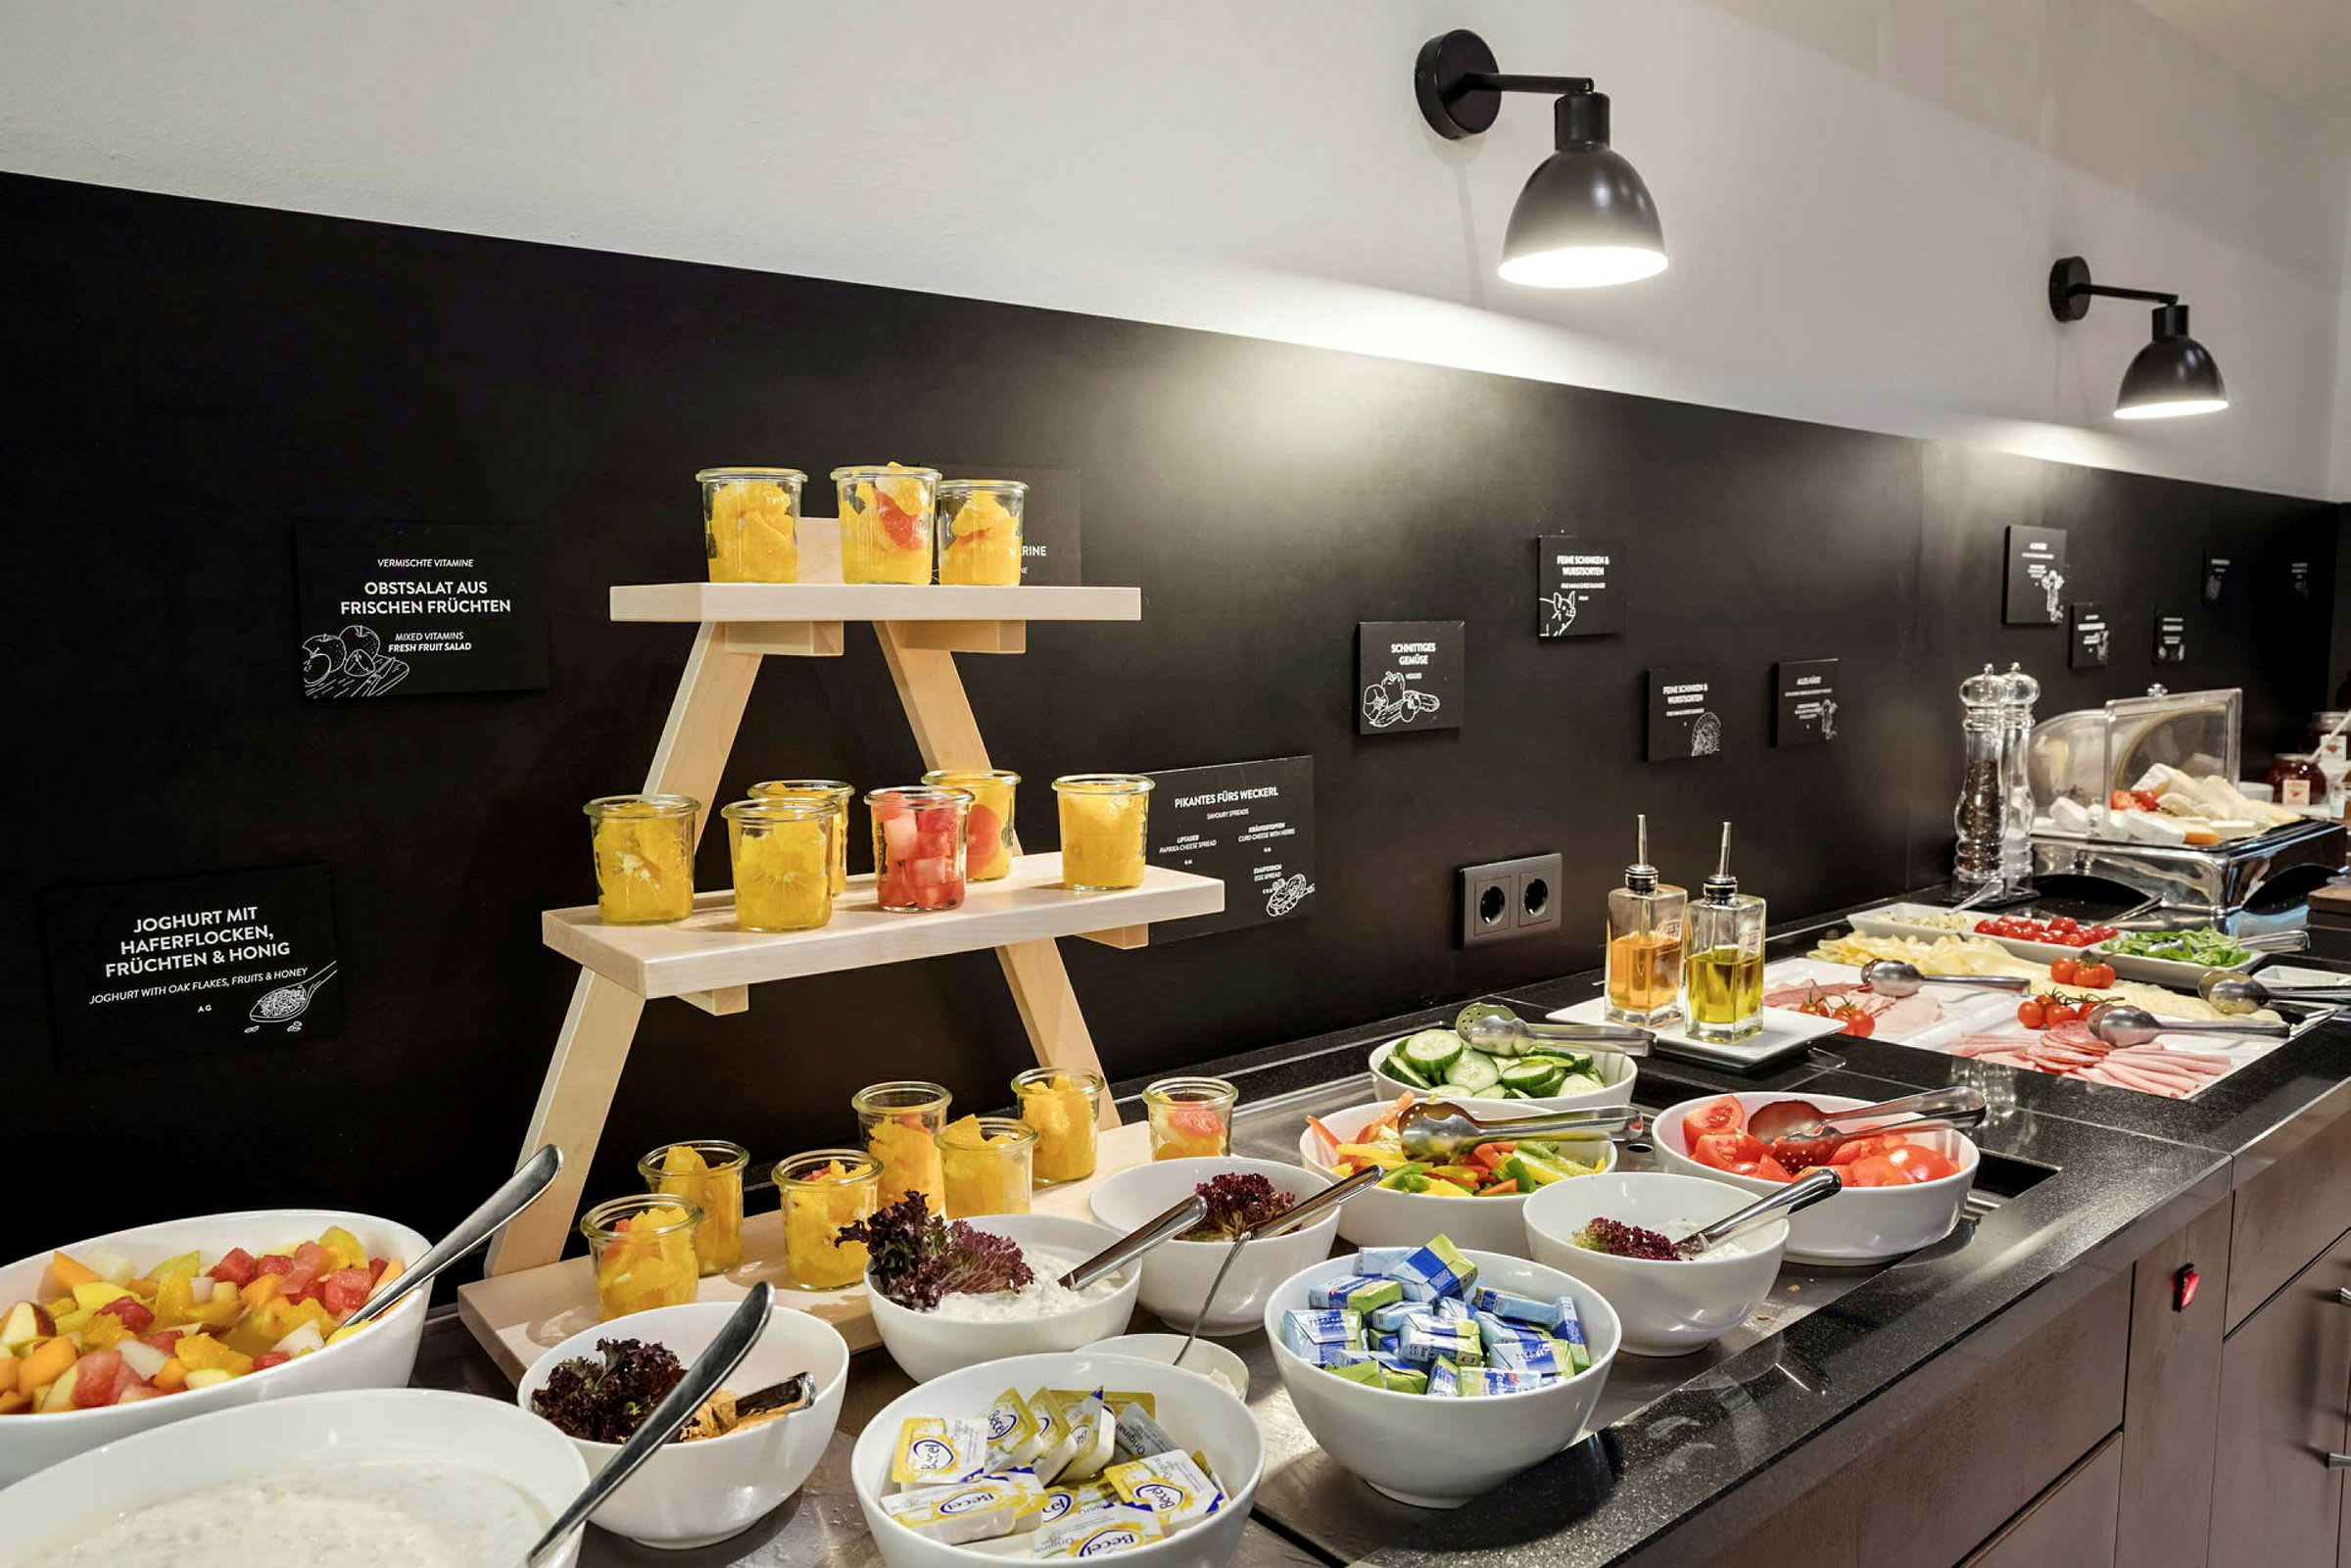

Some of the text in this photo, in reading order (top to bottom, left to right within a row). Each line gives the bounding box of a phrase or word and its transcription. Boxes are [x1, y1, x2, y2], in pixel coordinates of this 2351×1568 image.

[377, 558, 475, 568] VERMISCHTE VITAMINE
[364, 581, 488, 595] OBSTSALAT AUS
[341, 597, 511, 615] FRISCHEN FRÜCHTEN
[395, 632, 464, 641] MIXED VITAMINS
[388, 642, 472, 653] FRESH FRUIT SALAD
[1391, 642, 1436, 653] SCHNITTIGES
[1399, 653, 1429, 665] GEMÜSE
[1175, 786, 1279, 808] PIKANTES FÜRS WECKERL
[133, 906, 258, 933] JOGHURT MIT
[120, 925, 274, 955] HAFERFLOCKEN,
[105, 942, 290, 978] FRÜCHTEN & HONIG
[89, 967, 309, 1005] JOGHURT WITH OAK FLAKES, FRUITS & HONEY
[1087, 1533, 1135, 1556] Becel
